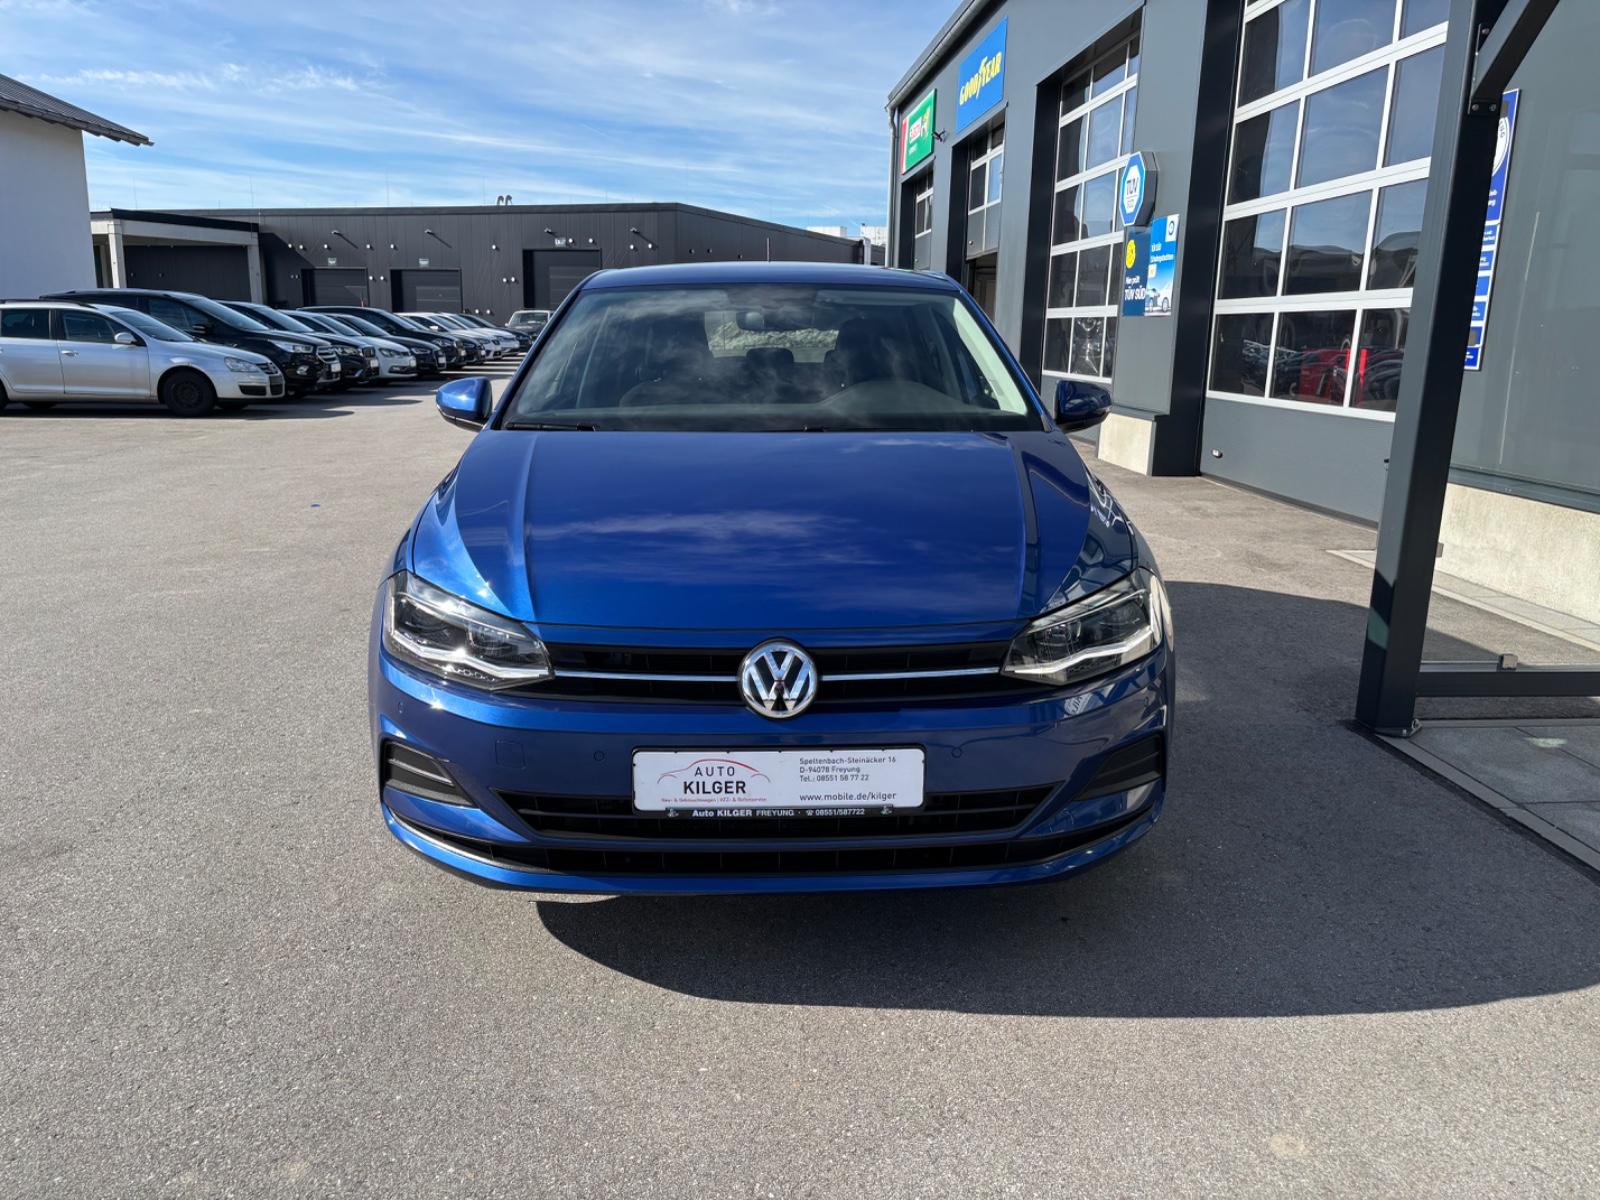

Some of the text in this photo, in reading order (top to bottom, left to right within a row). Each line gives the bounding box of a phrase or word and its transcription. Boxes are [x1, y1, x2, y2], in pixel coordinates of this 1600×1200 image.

[959, 51, 1002, 105] GOODYEAR
[1126, 176, 1139, 195] TÜV
[1125, 285, 1145, 300] TÜV SÜD
[888, 756, 896, 764] 16
[694, 766, 735, 777] AUTO
[831, 766, 861, 774] Freyung
[683, 781, 746, 794] KILGER
[800, 792, 896, 801] www.mobile.de/kilger
[692, 809, 715, 817] Auto
[716, 809, 753, 817] KILGER
[756, 809, 794, 817] FREYUNG
